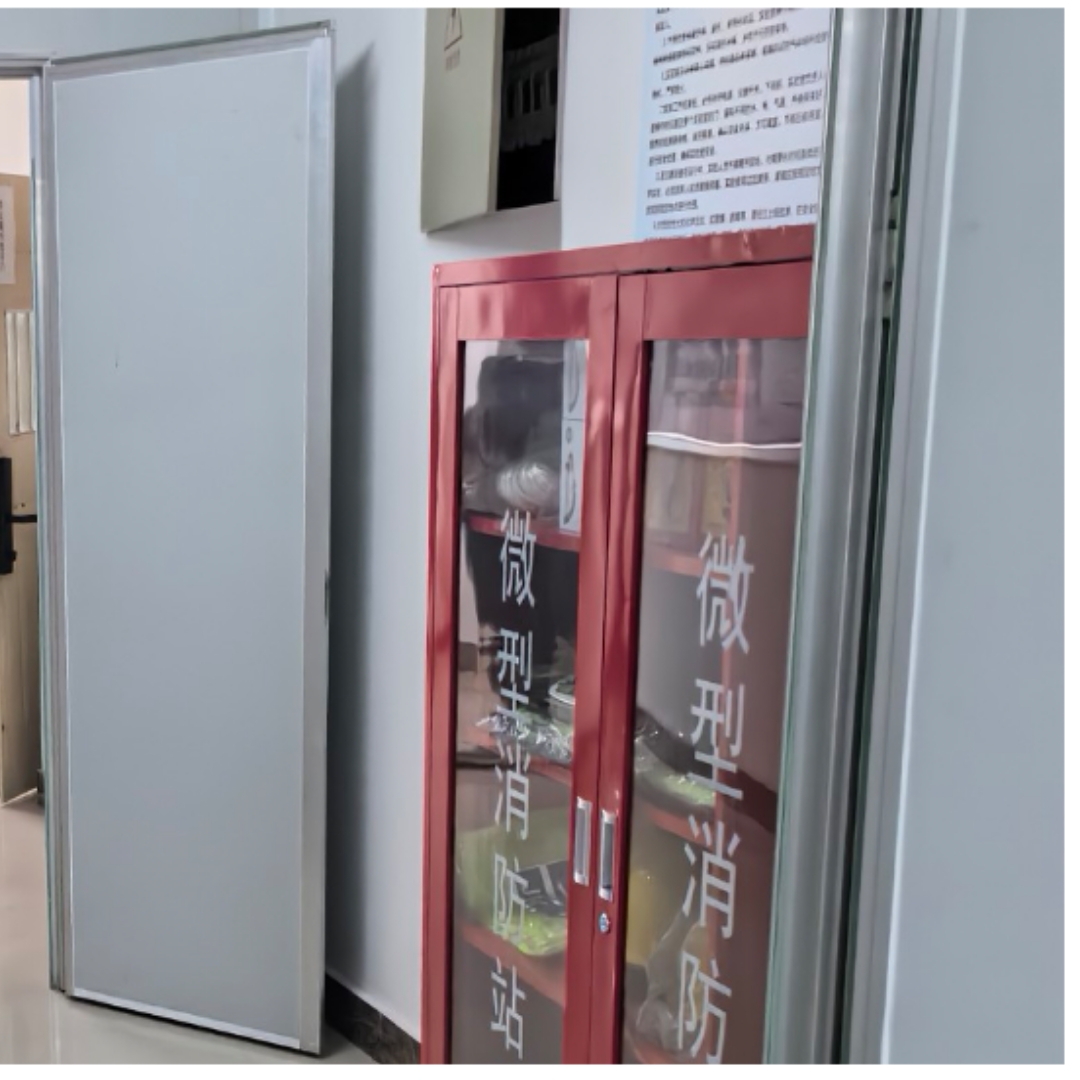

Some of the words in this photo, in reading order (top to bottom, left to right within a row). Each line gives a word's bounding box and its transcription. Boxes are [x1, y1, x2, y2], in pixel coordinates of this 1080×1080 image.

[491, 509, 537, 1060] 微型消防站
[679, 532, 755, 1064] 微型消防
